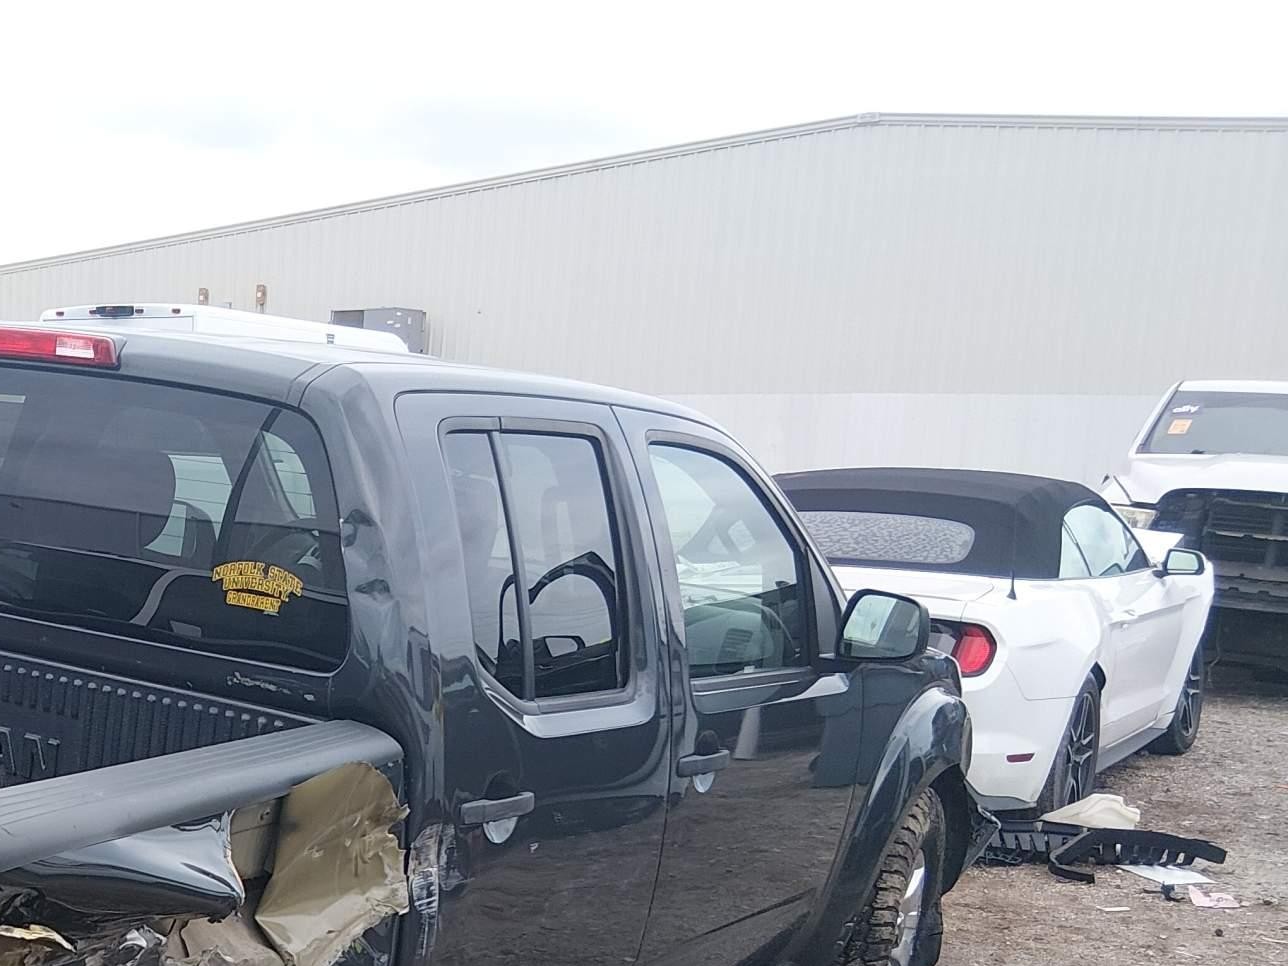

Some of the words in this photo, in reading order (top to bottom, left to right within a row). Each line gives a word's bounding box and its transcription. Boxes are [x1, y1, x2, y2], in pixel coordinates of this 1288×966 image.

[212, 561, 266, 582] NORFOLK
[267, 565, 304, 597] STATE
[222, 576, 289, 602] UNIVERSITY
